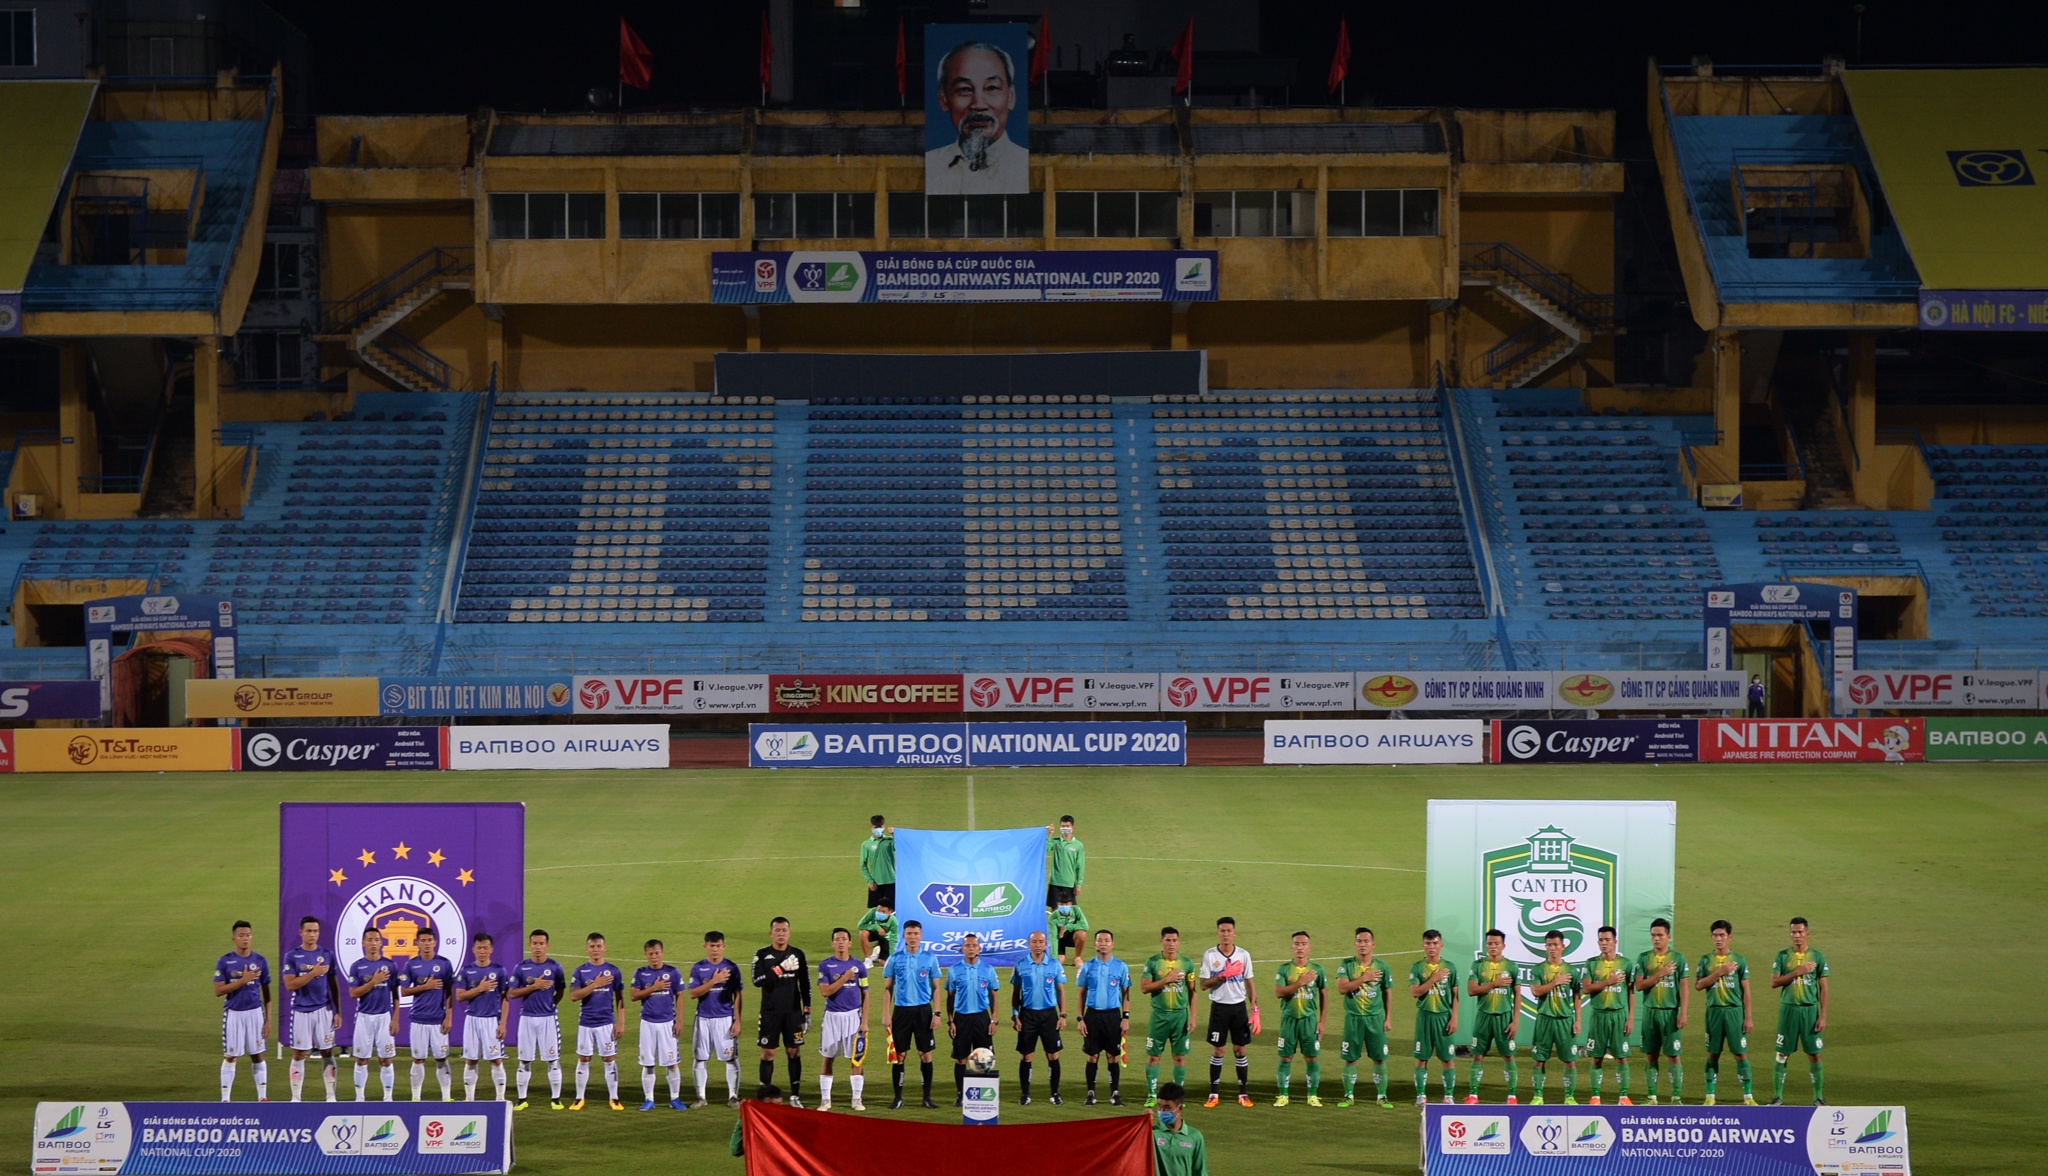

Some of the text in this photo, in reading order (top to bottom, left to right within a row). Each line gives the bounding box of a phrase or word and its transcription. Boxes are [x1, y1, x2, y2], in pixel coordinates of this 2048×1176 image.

[876, 256, 1036, 270] GIẢI BÓNG ĐÁ CÚP QUỐC GIA
[876, 272, 1160, 286] BAMBOO AIRWAYS NATIONAL CUP 2020
[1951, 300, 1970, 324] HÀ
[1972, 300, 1996, 328] NỘI
[2000, 304, 2015, 324] FC
[263, 688, 298, 700] T&T
[615, 680, 682, 704] VPF
[709, 684, 763, 692] V.league.VPF
[826, 684, 959, 703] KING COFFEE
[1005, 678, 1073, 703] VPF
[1202, 678, 1269, 702] VPF
[1425, 676, 1544, 700] CÔNG TY CP CẢNG QUẢNG NINH
[1621, 675, 1740, 699] CÔNG TY CP CẢNG QUẢNG NINH
[1884, 675, 1952, 700] VPF
[408, 682, 426, 710] BÍT
[455, 682, 476, 714] DỆT
[480, 686, 502, 708] KIM
[506, 682, 521, 708] HÀ
[524, 681, 545, 714] NỘI
[1274, 734, 1473, 749] BAMBOO AIRWAYS
[1717, 722, 1862, 748] NITTAN
[1929, 731, 2026, 746] BAMBOO
[100, 739, 139, 752] T&T
[460, 739, 660, 754] BAMBOO AIRWAYS
[824, 734, 962, 755] BAMBOO
[972, 733, 1180, 753] NATIONAL CUP 2020
[1546, 731, 1634, 758] Casper
[286, 738, 376, 766] Casper
[896, 754, 962, 764] AIRWAYS
[1722, 751, 1857, 759] JAPANESE FIRE PROTECTION COMPANY
[1512, 878, 1587, 892] CAN THO
[350, 883, 432, 912] HANOI
[1544, 899, 1576, 911] CFC
[973, 905, 1012, 913] BAMBOO
[942, 929, 1004, 942] SHNE
[1211, 1031, 1220, 1042] 31
[143, 1116, 161, 1125] GIẢI
[162, 1116, 186, 1125] BÓNG
[188, 1116, 200, 1125] ĐÁ
[201, 1116, 218, 1125] CÚP
[220, 1116, 244, 1126] QUỐC
[1620, 1116, 1639, 1125] GIẢI
[1640, 1116, 1665, 1125] BÓNG
[1666, 1116, 1678, 1125] ĐÁ
[1680, 1116, 1698, 1125] CÚP
[1700, 1116, 1723, 1126] QUỐC
[143, 1128, 312, 1143] BAMBOO AIRWAYS
[1622, 1128, 1796, 1144] BAMBOO AIRWAYS
[140, 1148, 241, 1157] NATIONAL CUP 2020
[1622, 1148, 1724, 1158] NATIONAL CUP 2020
